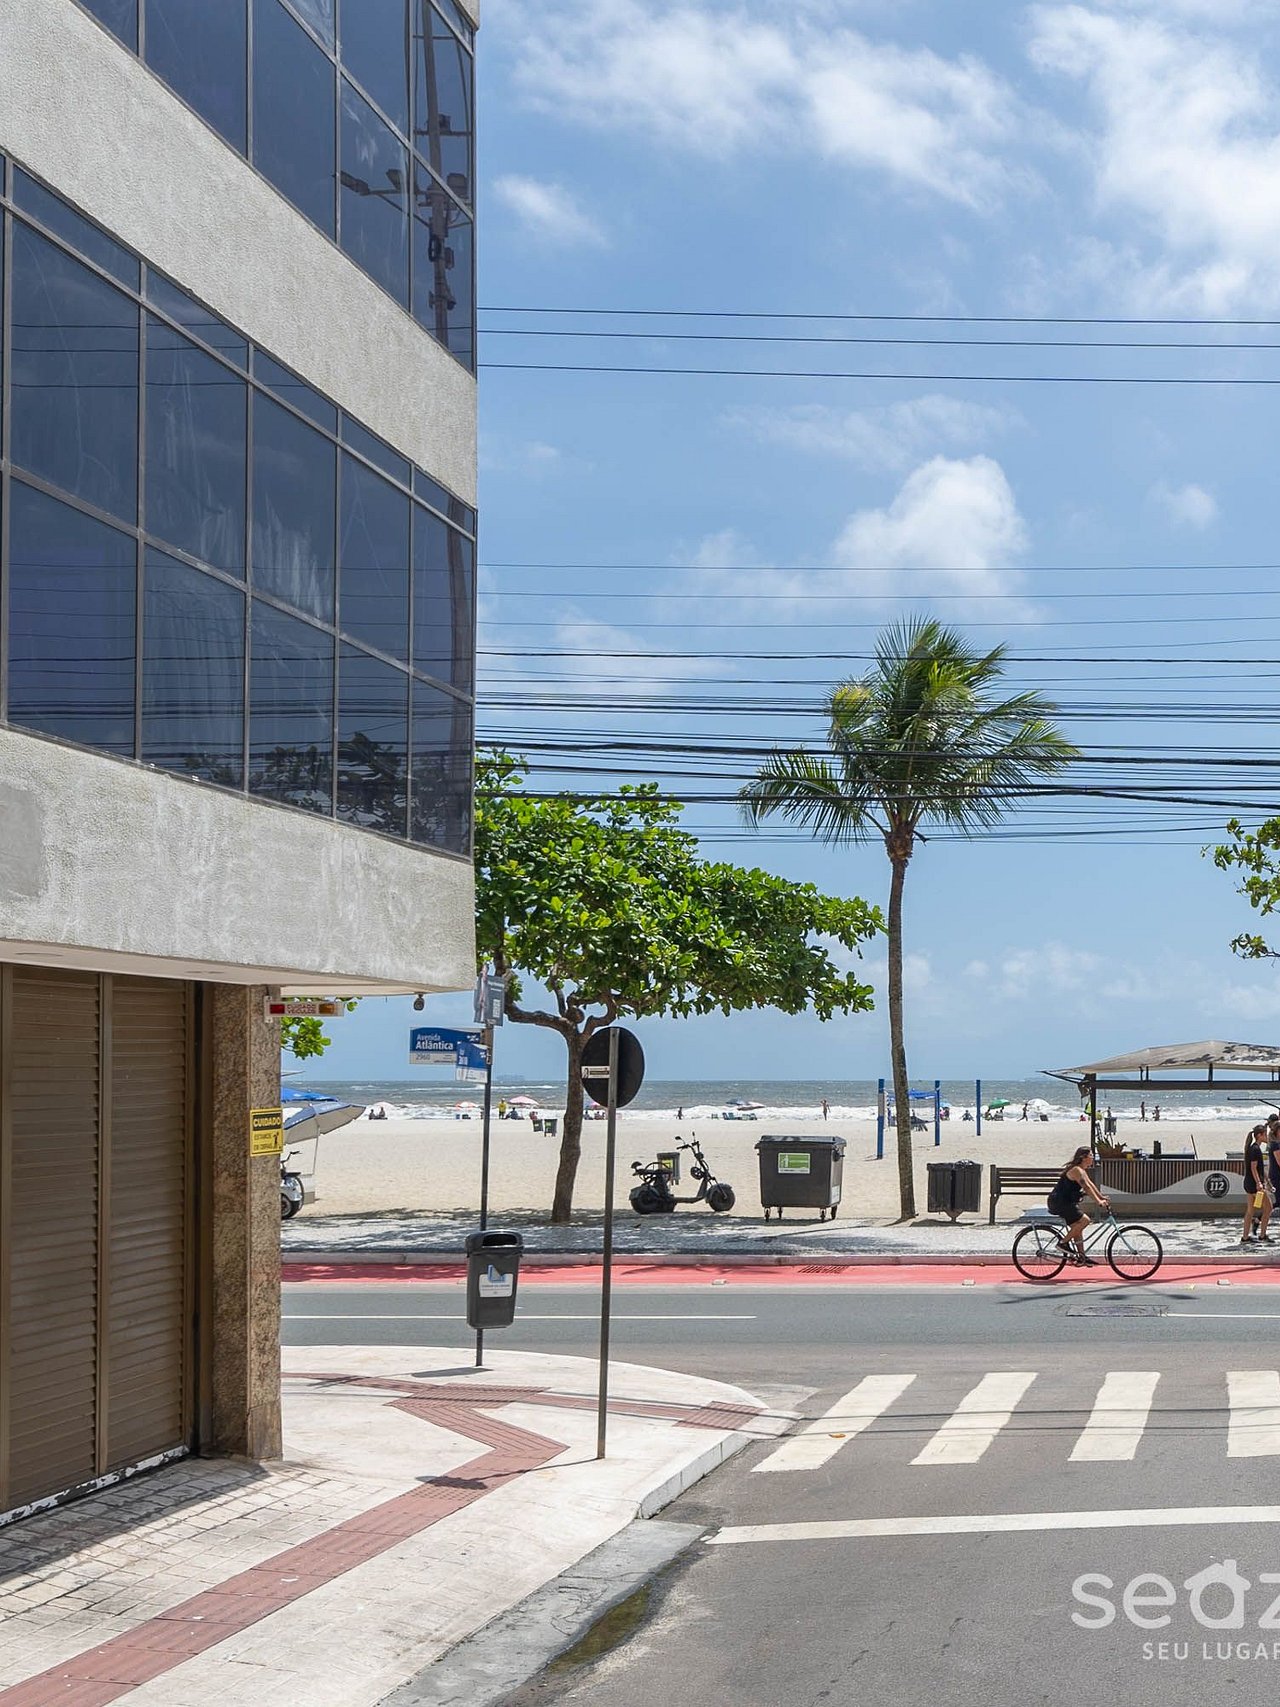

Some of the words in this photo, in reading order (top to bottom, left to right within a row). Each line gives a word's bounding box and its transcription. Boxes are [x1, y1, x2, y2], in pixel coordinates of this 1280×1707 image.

[416, 1033, 441, 1041] Avenida
[415, 1040, 454, 1050] Atlântica
[253, 1116, 281, 1128] CUIDADO
[1209, 1181, 1225, 1191] 112
